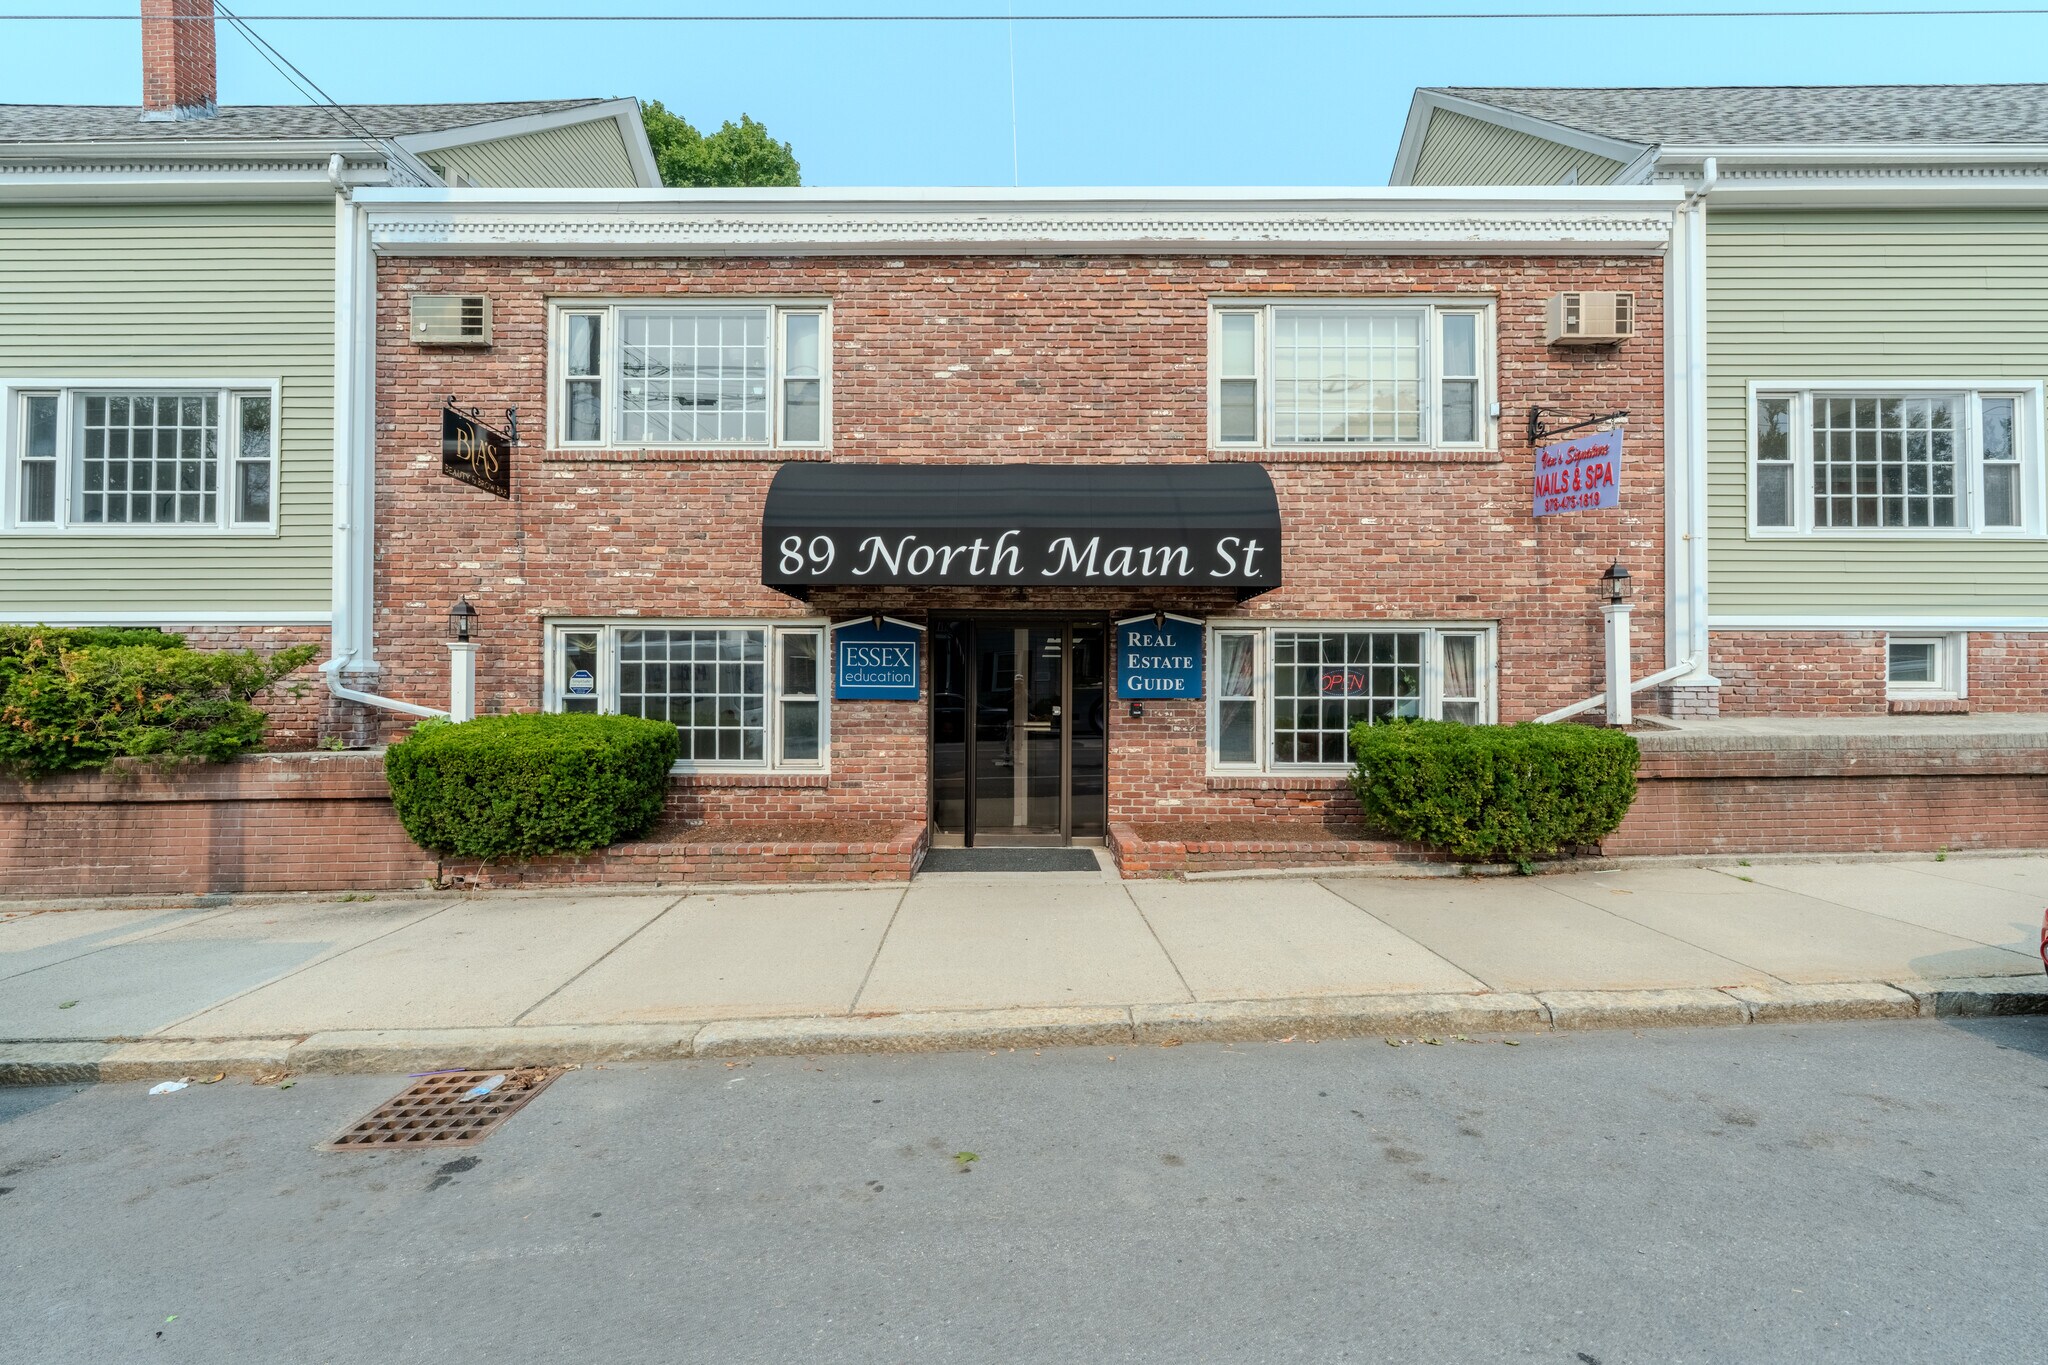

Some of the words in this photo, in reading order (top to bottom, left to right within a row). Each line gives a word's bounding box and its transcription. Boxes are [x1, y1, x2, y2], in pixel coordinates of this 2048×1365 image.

[445, 464, 471, 481] BEAUTY
[478, 478, 495, 491] BROW
[497, 486, 507, 496] BAR
[1536, 470, 1570, 497] NAILS
[1572, 468, 1581, 491] &
[1585, 462, 1614, 489] SPA
[778, 534, 836, 576] 89
[851, 529, 1024, 577] North
[1041, 536, 1194, 578] Main
[1127, 632, 1176, 647] REAL
[846, 647, 911, 667] ESSEX
[1127, 653, 1193, 669] ESTATE
[845, 668, 911, 683] education
[1127, 675, 1185, 691] GUIDE
[1320, 674, 1365, 691] OPEN
